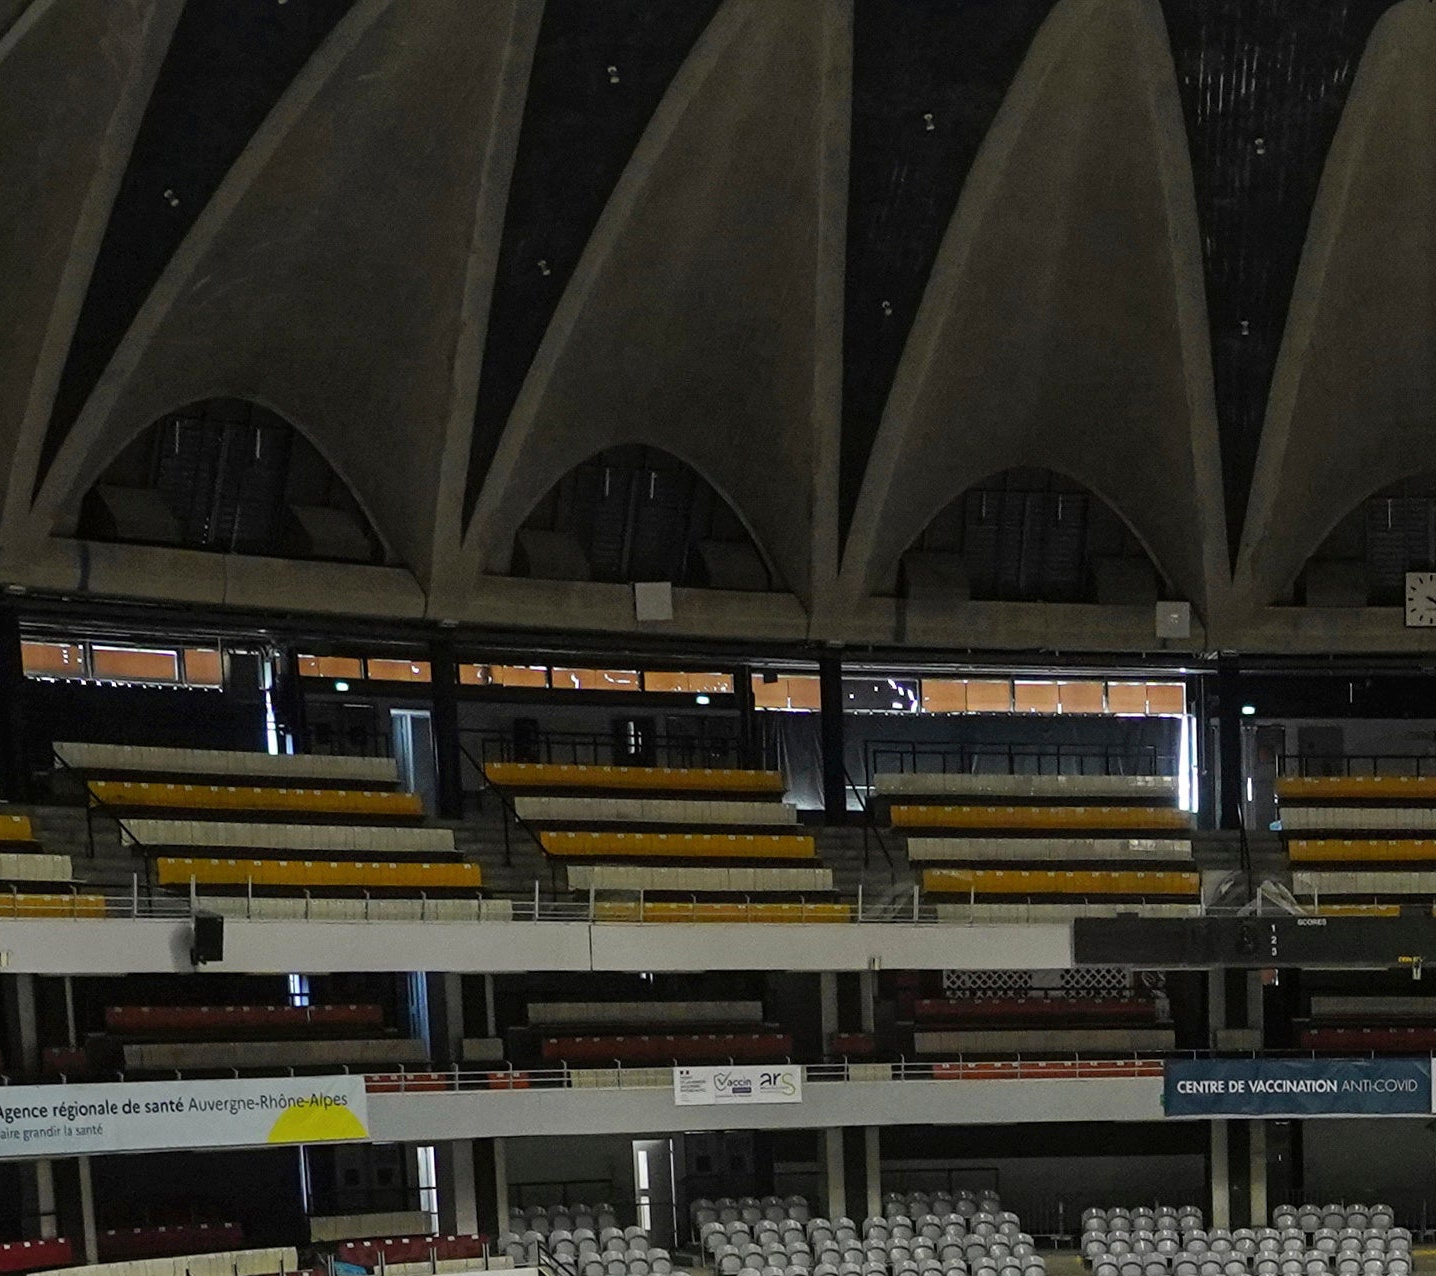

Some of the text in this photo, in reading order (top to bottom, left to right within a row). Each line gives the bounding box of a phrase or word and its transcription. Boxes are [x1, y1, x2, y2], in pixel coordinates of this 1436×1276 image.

[1297, 918, 1327, 927] SCORES
[1271, 936, 1277, 945] 2
[1176, 1078, 1419, 1094] CENTRE DE VACCINATION ANTI-COVID
[52, 1099, 118, 1120] régionale
[122, 1099, 141, 1114] de
[145, 1098, 184, 1113] santé
[188, 1092, 348, 1115] Auvergne-Rhône-Alpes
[23, 1125, 60, 1141] grandir
[64, 1126, 73, 1136] la
[75, 1124, 103, 1135] santé
